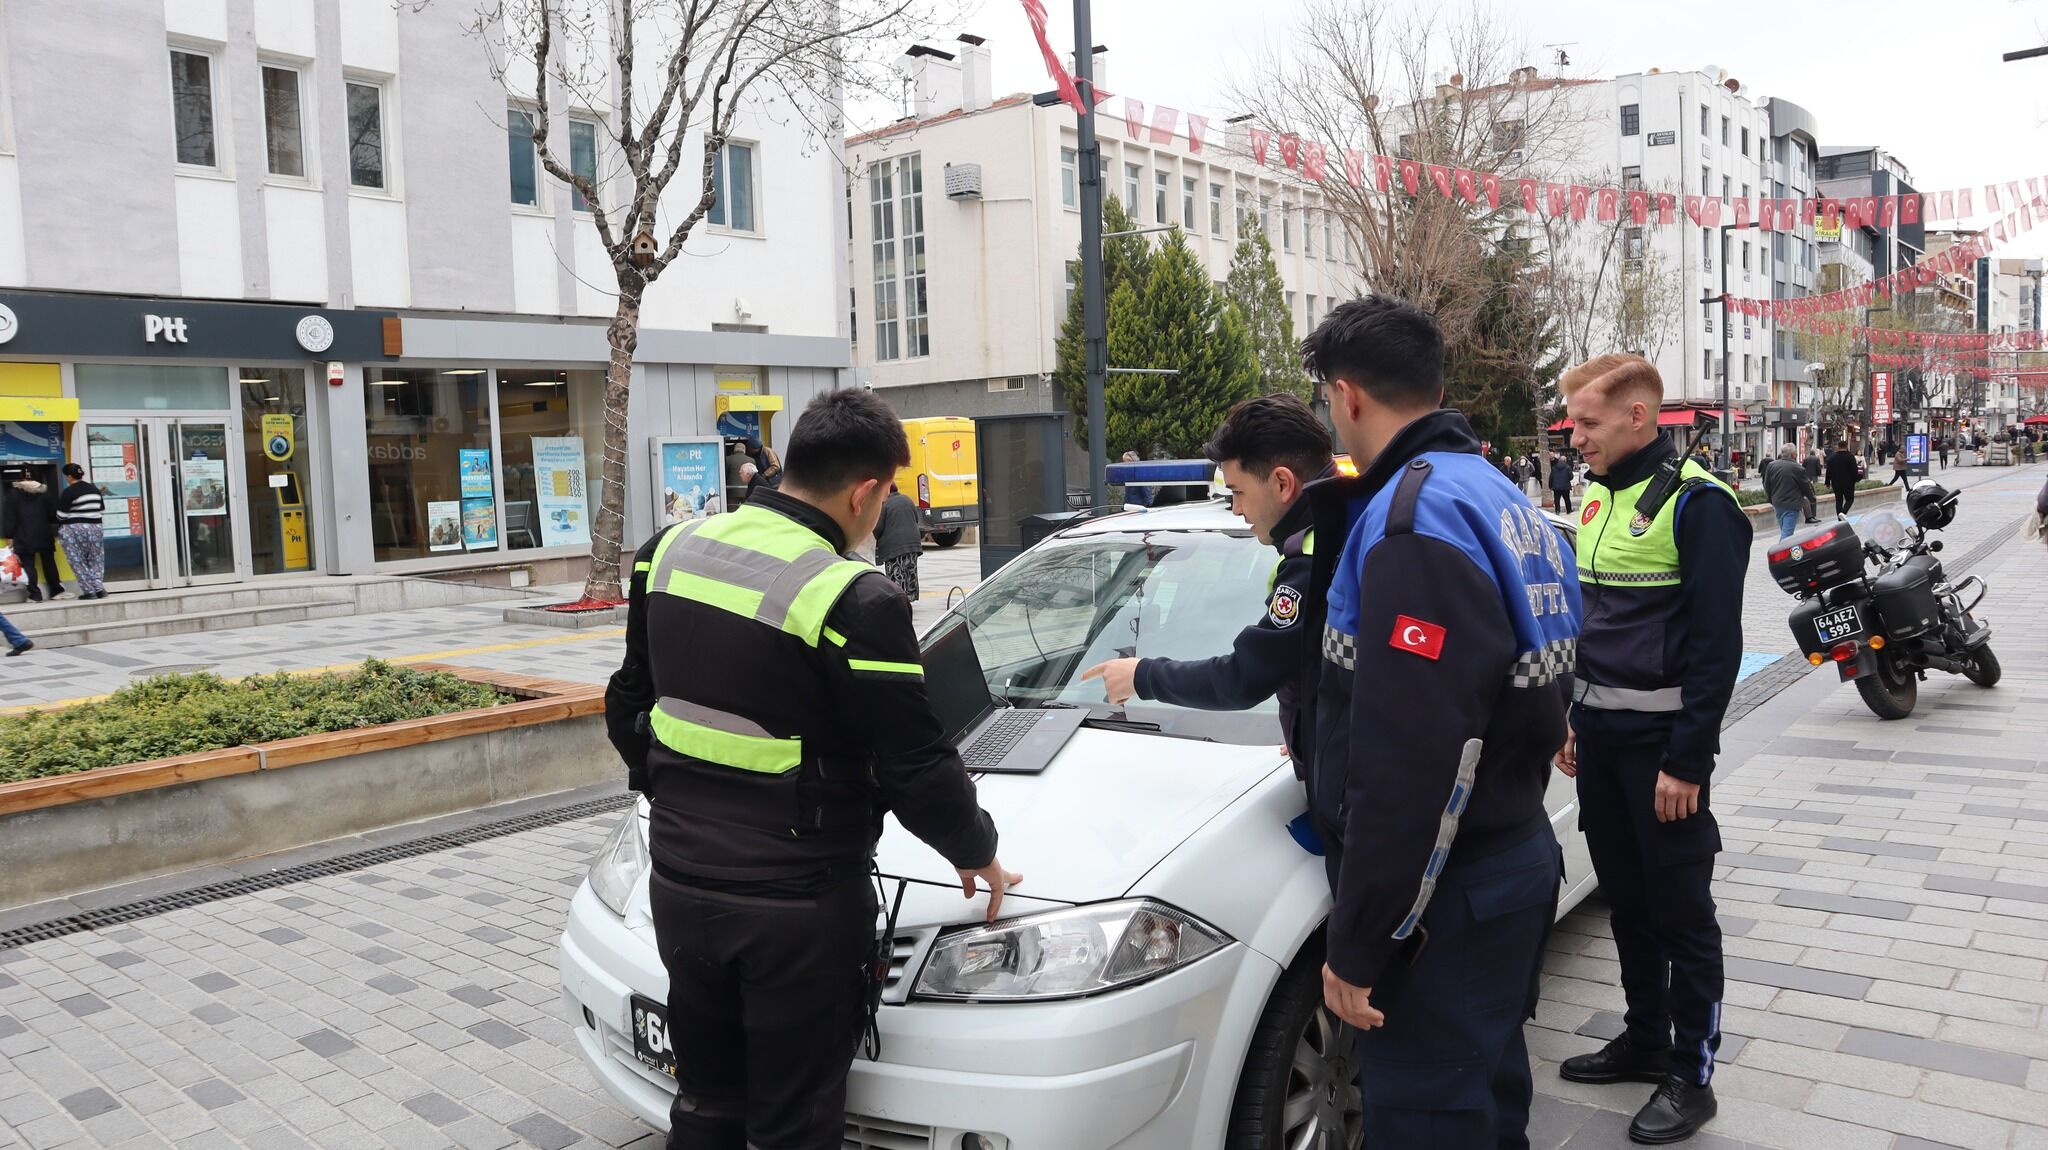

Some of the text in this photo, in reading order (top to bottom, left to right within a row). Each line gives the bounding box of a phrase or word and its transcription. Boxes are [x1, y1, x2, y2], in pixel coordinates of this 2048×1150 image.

[144, 314, 188, 343] Ptt
[689, 449, 702, 460] Ptt
[1818, 609, 1855, 628] 64 AEZ
[1829, 623, 1851, 637] 599
